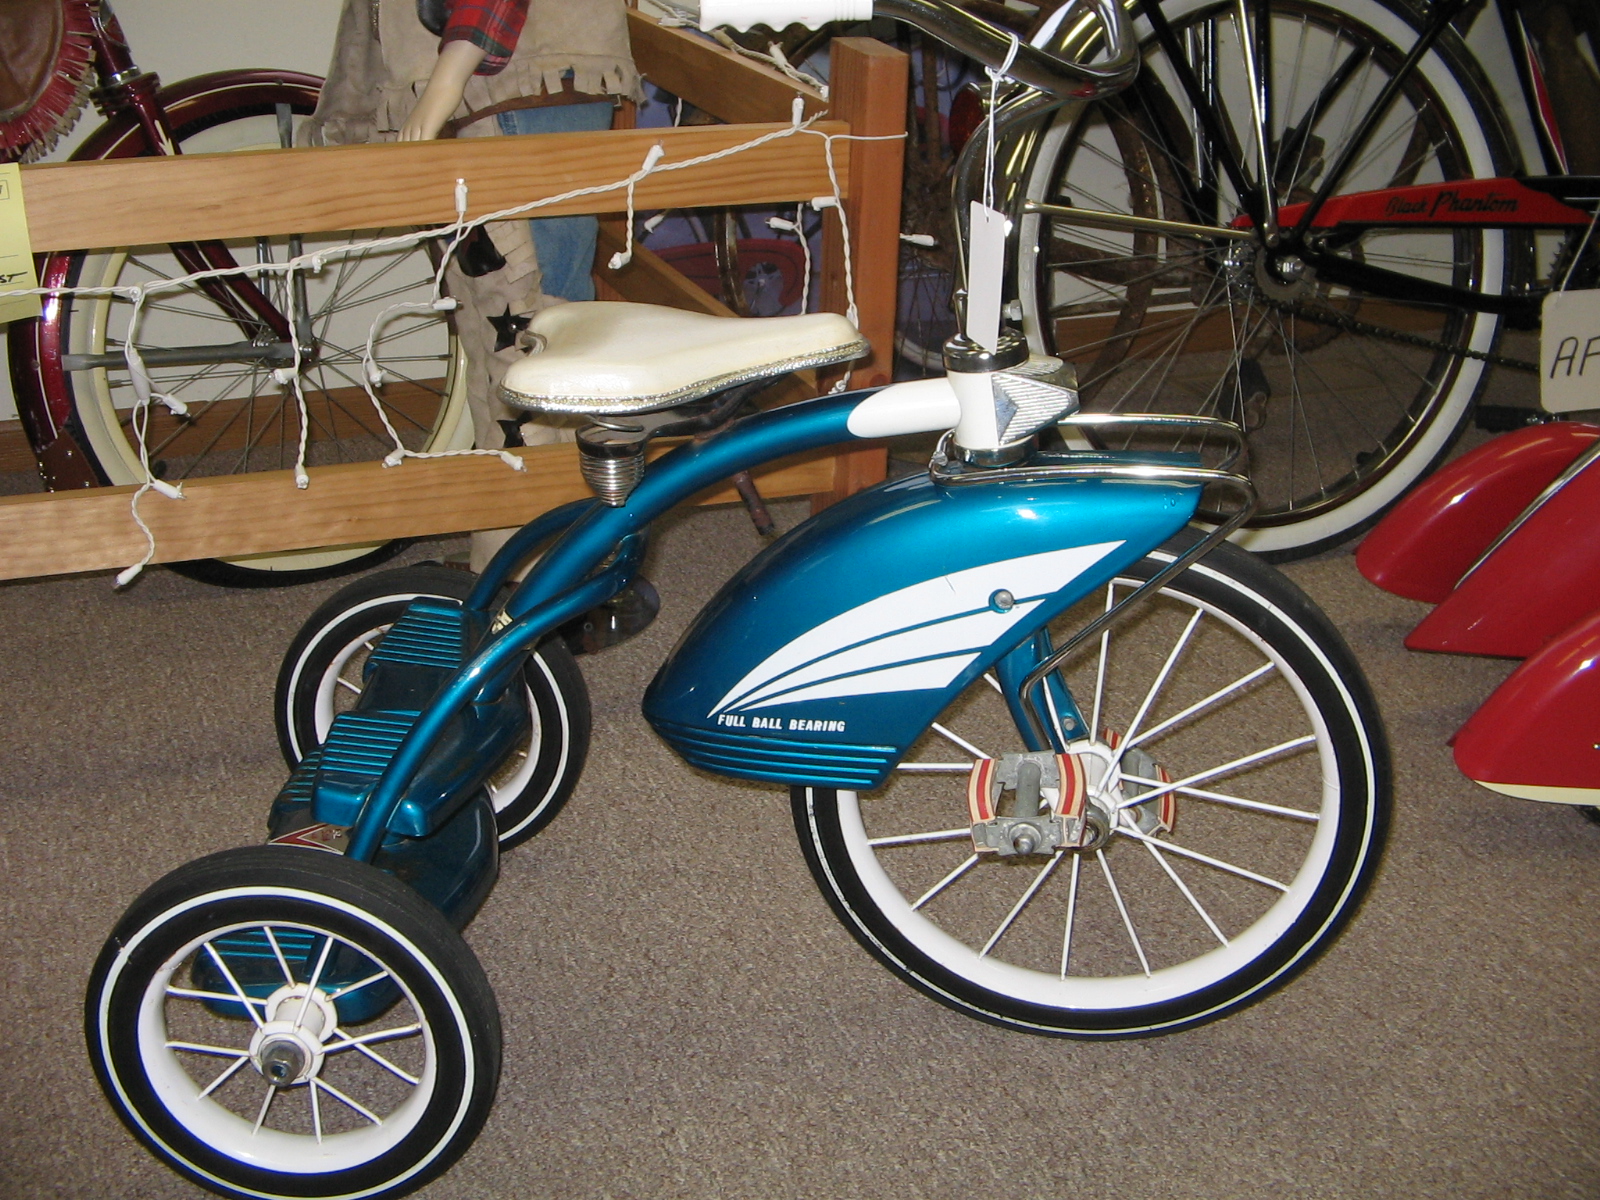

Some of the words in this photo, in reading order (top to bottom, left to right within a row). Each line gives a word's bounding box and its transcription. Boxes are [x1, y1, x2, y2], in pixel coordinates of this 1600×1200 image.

[1428, 191, 1519, 218] Phantom
[718, 714, 746, 727] FULL
[752, 717, 783, 730] BALL
[789, 719, 846, 732] BEARING
